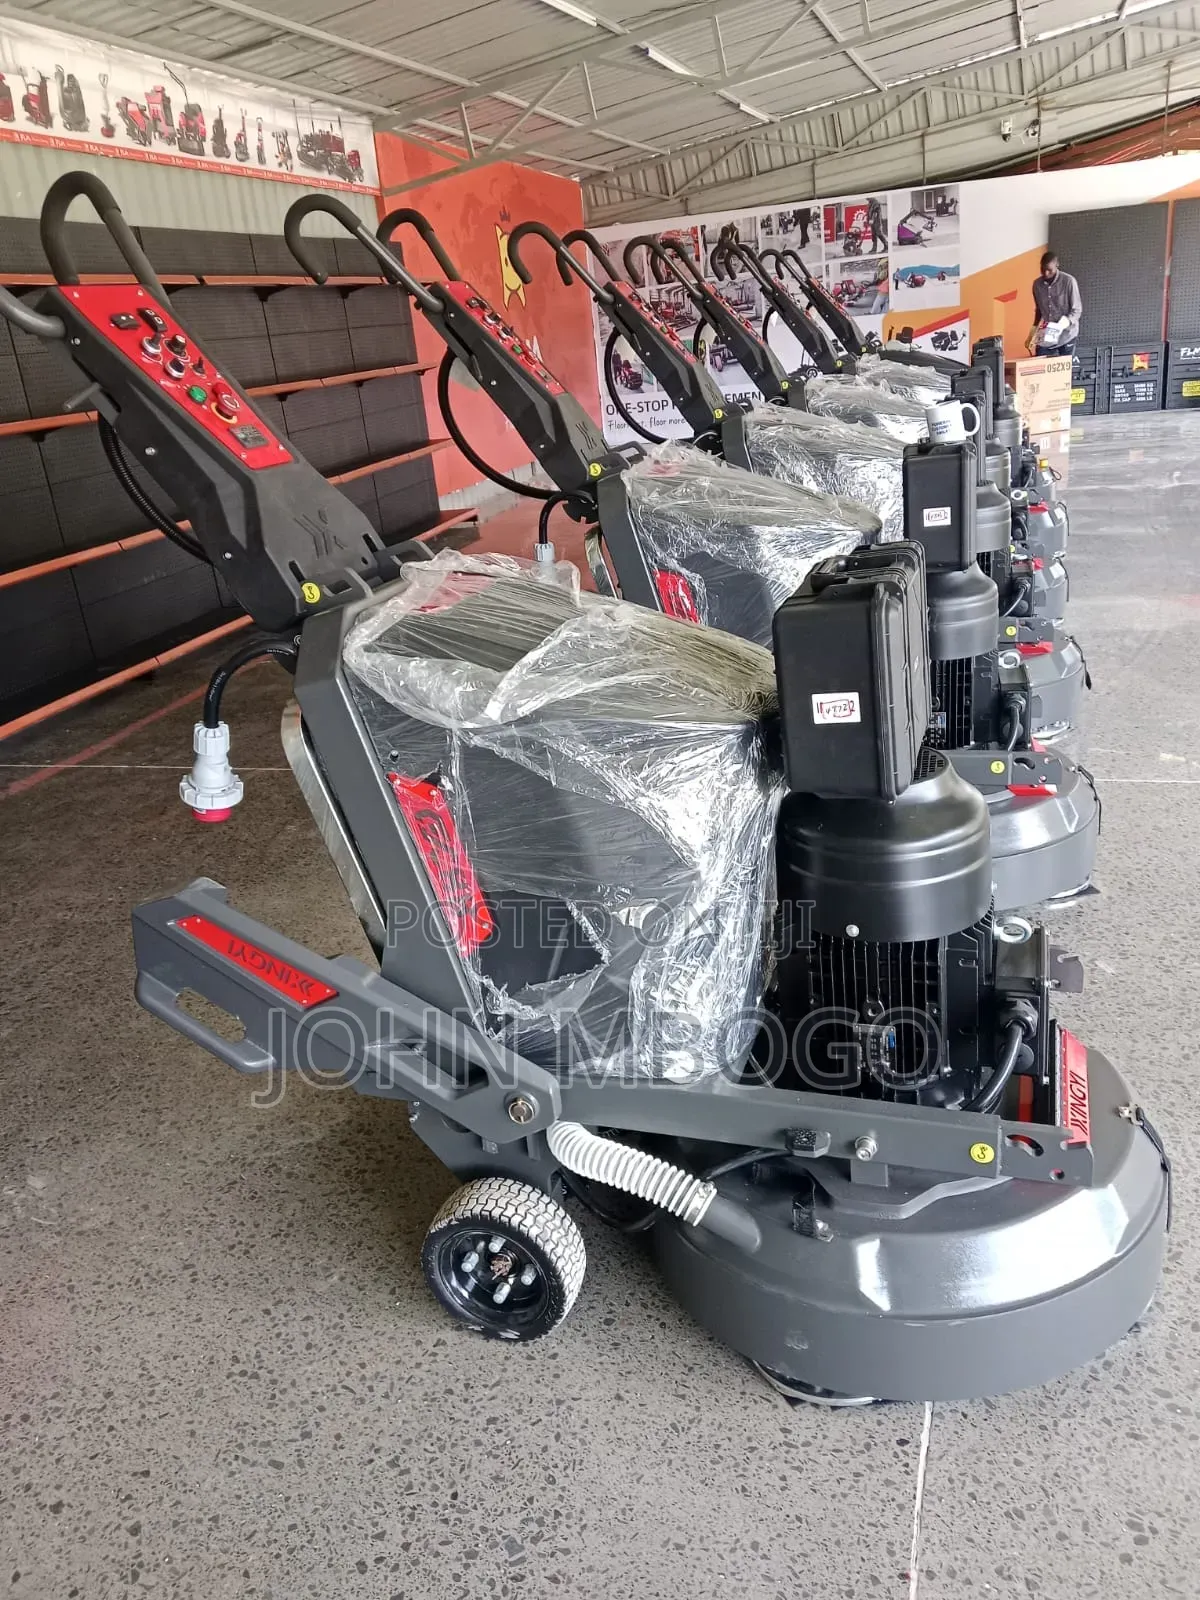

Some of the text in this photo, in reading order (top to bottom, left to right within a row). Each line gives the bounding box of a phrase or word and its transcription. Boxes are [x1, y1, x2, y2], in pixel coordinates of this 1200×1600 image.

[1047, 361, 1071, 373] GX250
[606, 400, 669, 416] OE-STOP
[649, 416, 667, 428] floor
[227, 939, 314, 997] XINGYI
[1069, 1069, 1088, 1136] XINGYI
